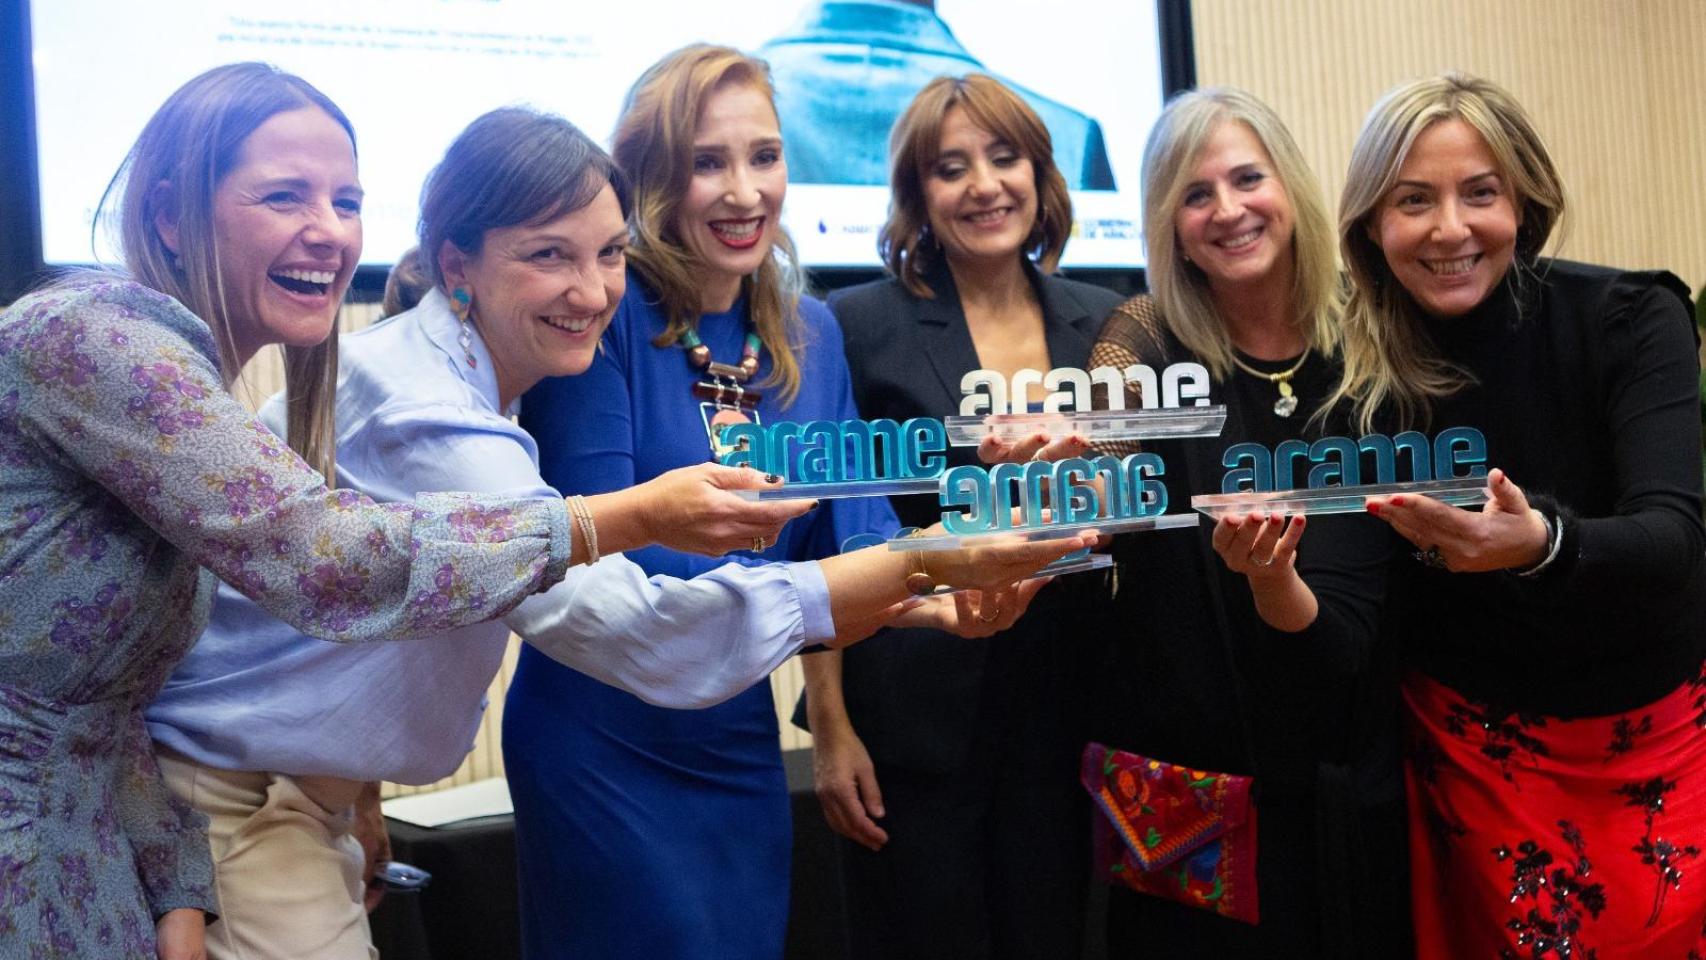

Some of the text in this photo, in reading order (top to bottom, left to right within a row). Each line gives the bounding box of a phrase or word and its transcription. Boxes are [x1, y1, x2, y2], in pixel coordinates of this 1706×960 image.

[959, 362, 1211, 417] arame
[719, 417, 948, 484] arame
[1222, 426, 1488, 494] arame
